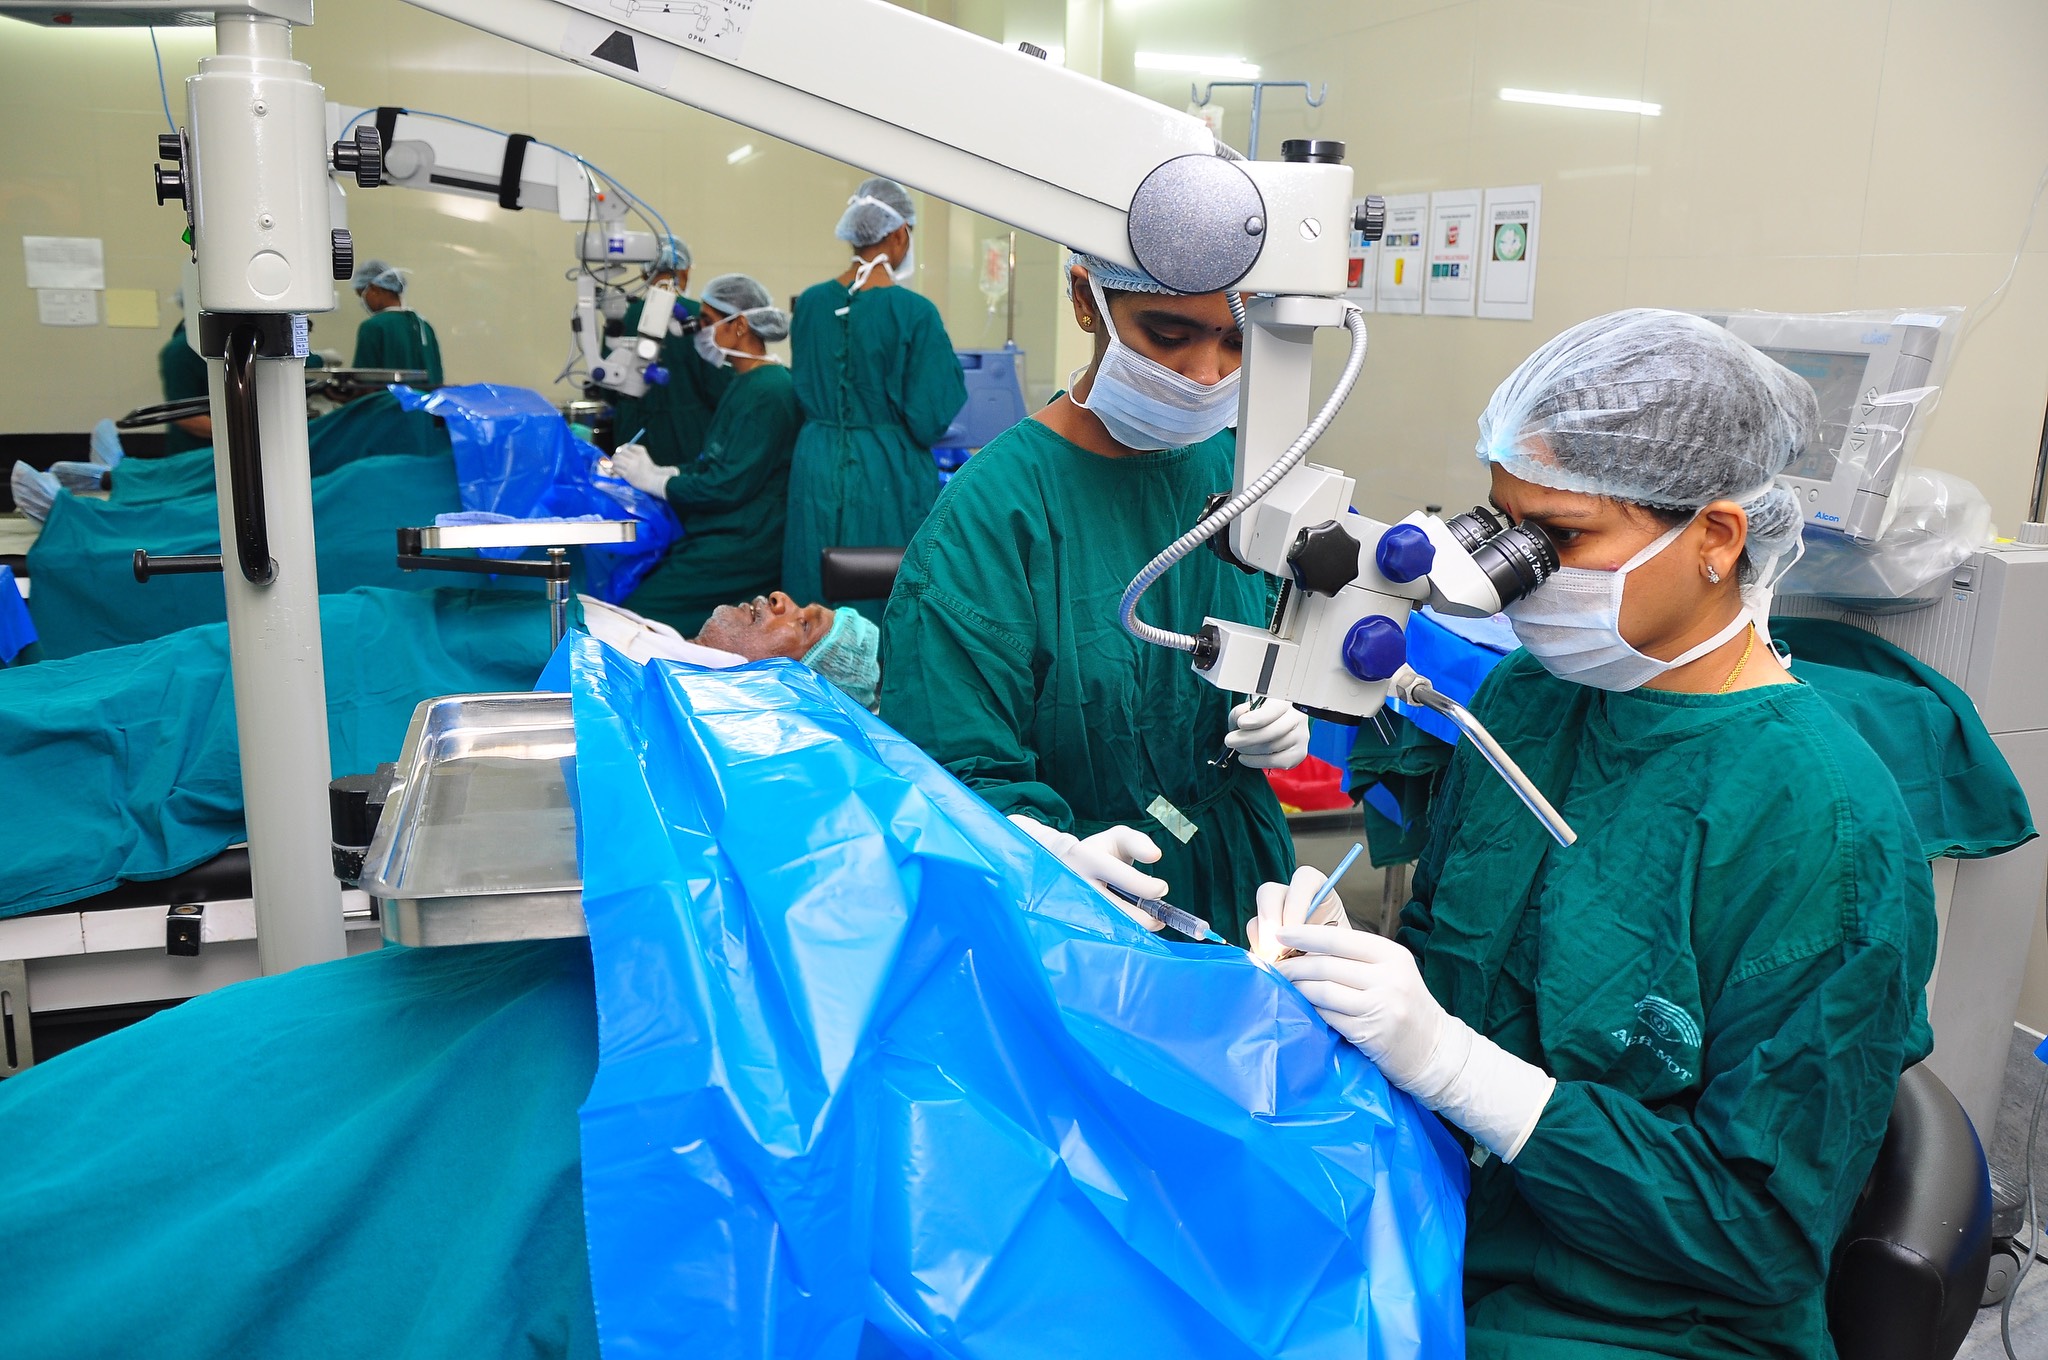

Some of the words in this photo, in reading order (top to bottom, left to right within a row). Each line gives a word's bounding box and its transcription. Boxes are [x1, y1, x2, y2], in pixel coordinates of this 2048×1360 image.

[688, 33, 706, 44] OPMI
[1814, 511, 1840, 522] Alcon
[1471, 527, 1487, 545] Carl
[1520, 543, 1537, 563] Carl
[1531, 561, 1544, 584] Zeiss
